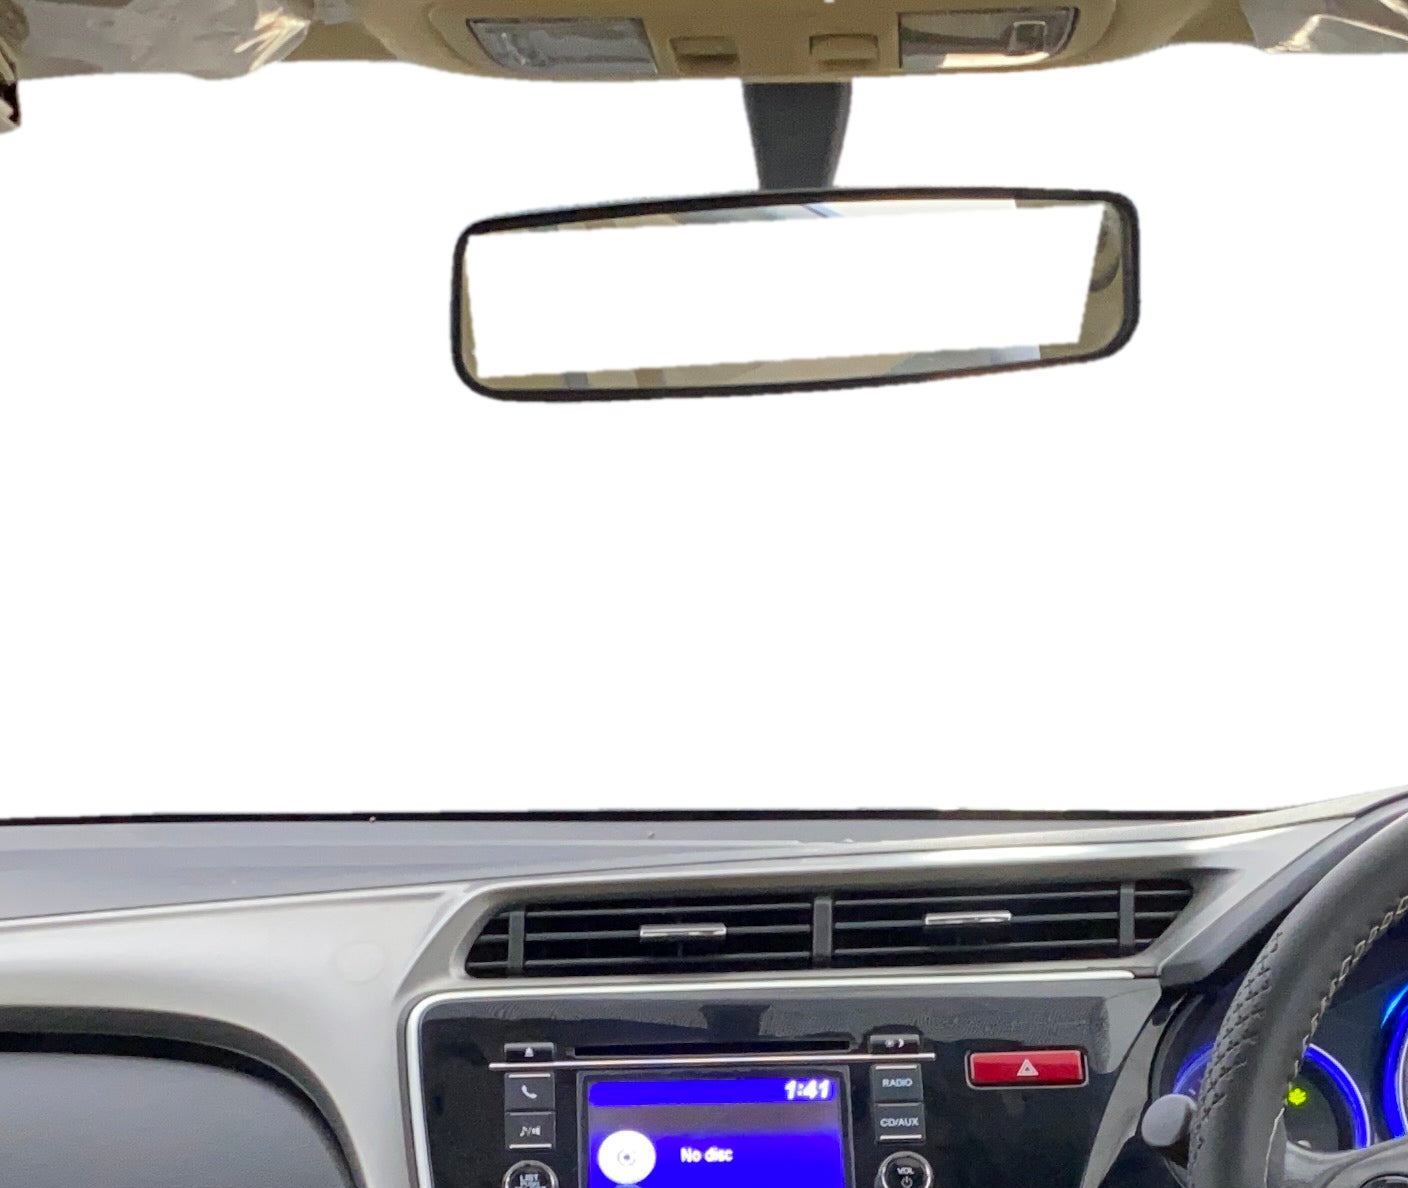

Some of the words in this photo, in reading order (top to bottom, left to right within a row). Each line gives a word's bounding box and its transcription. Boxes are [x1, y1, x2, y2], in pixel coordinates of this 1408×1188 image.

[882, 1078, 913, 1087] RADIO
[784, 1079, 831, 1100] 1:41
[879, 1118, 919, 1127] CD/AUX
[680, 1146, 702, 1163] No
[704, 1146, 734, 1163] disc
[897, 1167, 914, 1175] VOL
